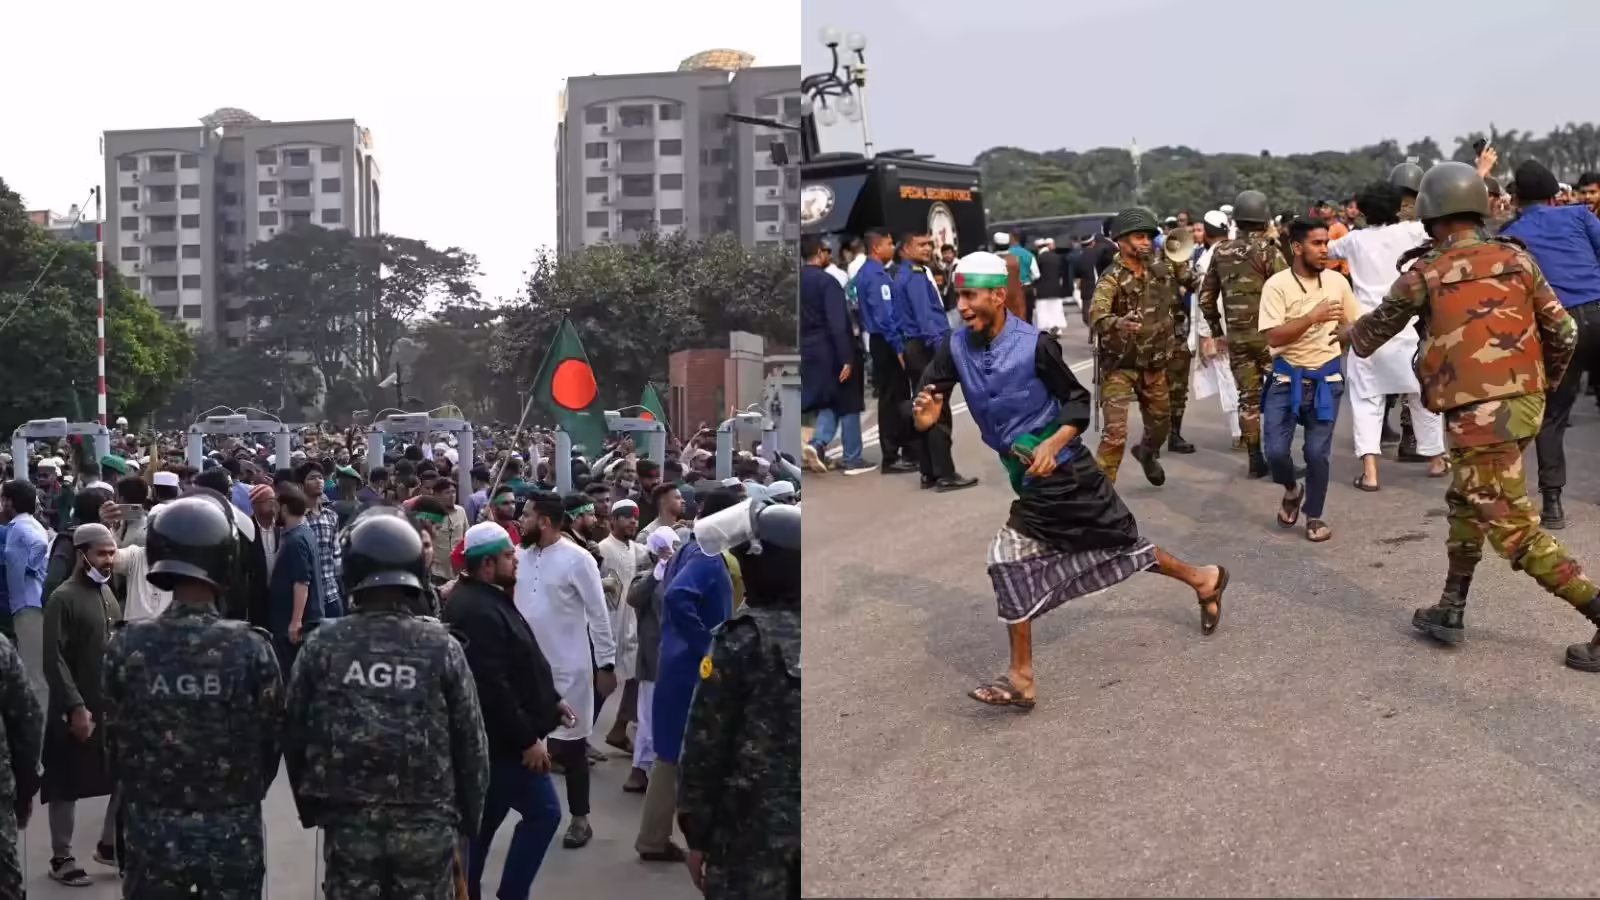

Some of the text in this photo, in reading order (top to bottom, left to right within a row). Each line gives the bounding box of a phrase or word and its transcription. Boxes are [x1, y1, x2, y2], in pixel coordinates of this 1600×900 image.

[900, 185, 973, 202] SPECIAL SECURITY FORCE
[151, 673, 222, 696] AGB
[343, 660, 417, 690] AGB
